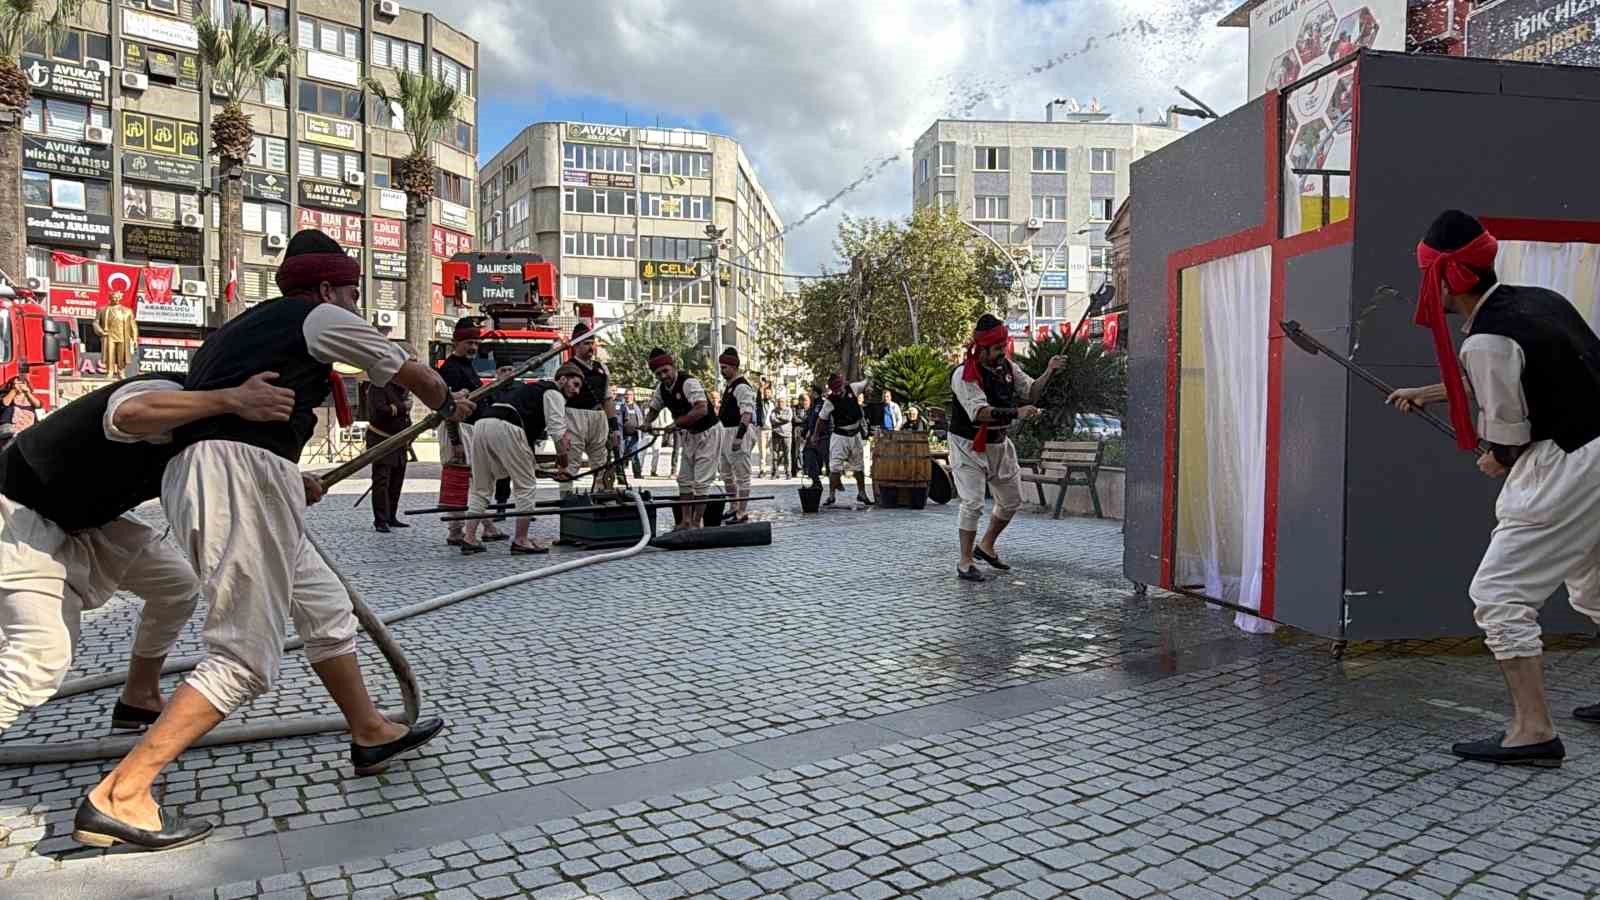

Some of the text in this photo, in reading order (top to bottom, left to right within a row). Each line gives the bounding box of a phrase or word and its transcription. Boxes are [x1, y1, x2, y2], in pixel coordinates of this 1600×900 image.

[54, 64, 101, 80] AVUKAT
[580, 125, 629, 137] AVUKAT
[25, 147, 66, 162] NİHAN
[45, 141, 91, 155] AVUKAT
[314, 185, 352, 197] AVUKAT
[476, 263, 522, 274] BALIKESİR
[482, 286, 515, 298] İTFAİYE
[143, 346, 188, 360] ZEYTİN
